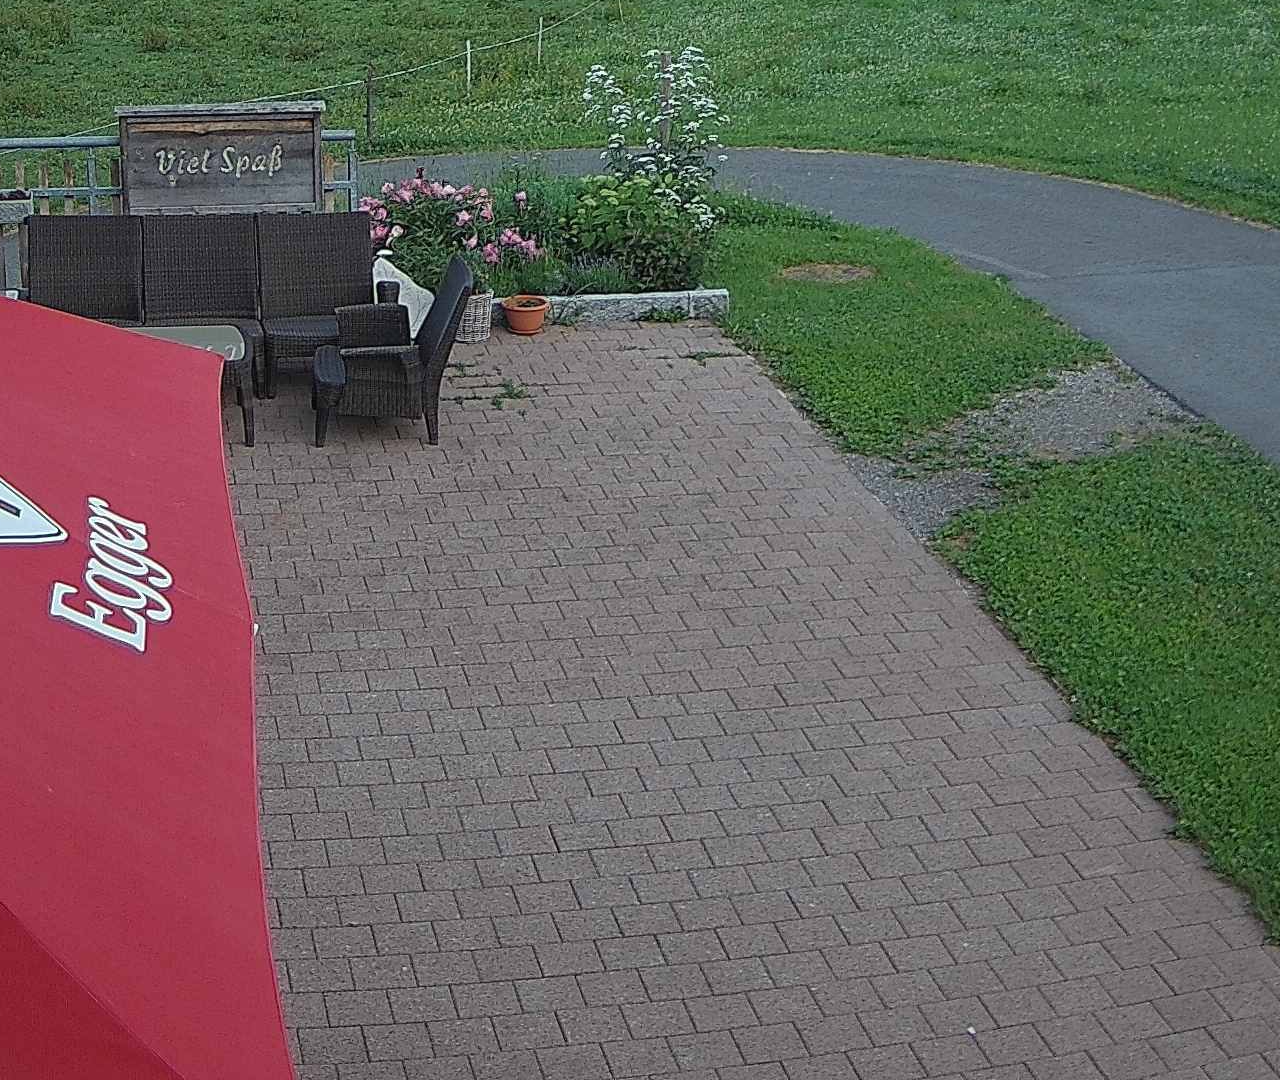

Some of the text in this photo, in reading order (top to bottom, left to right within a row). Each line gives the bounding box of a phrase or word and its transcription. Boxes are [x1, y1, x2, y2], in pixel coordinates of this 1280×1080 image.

[155, 145, 283, 179] Viel Spaß
[50, 496, 173, 652] Egger
